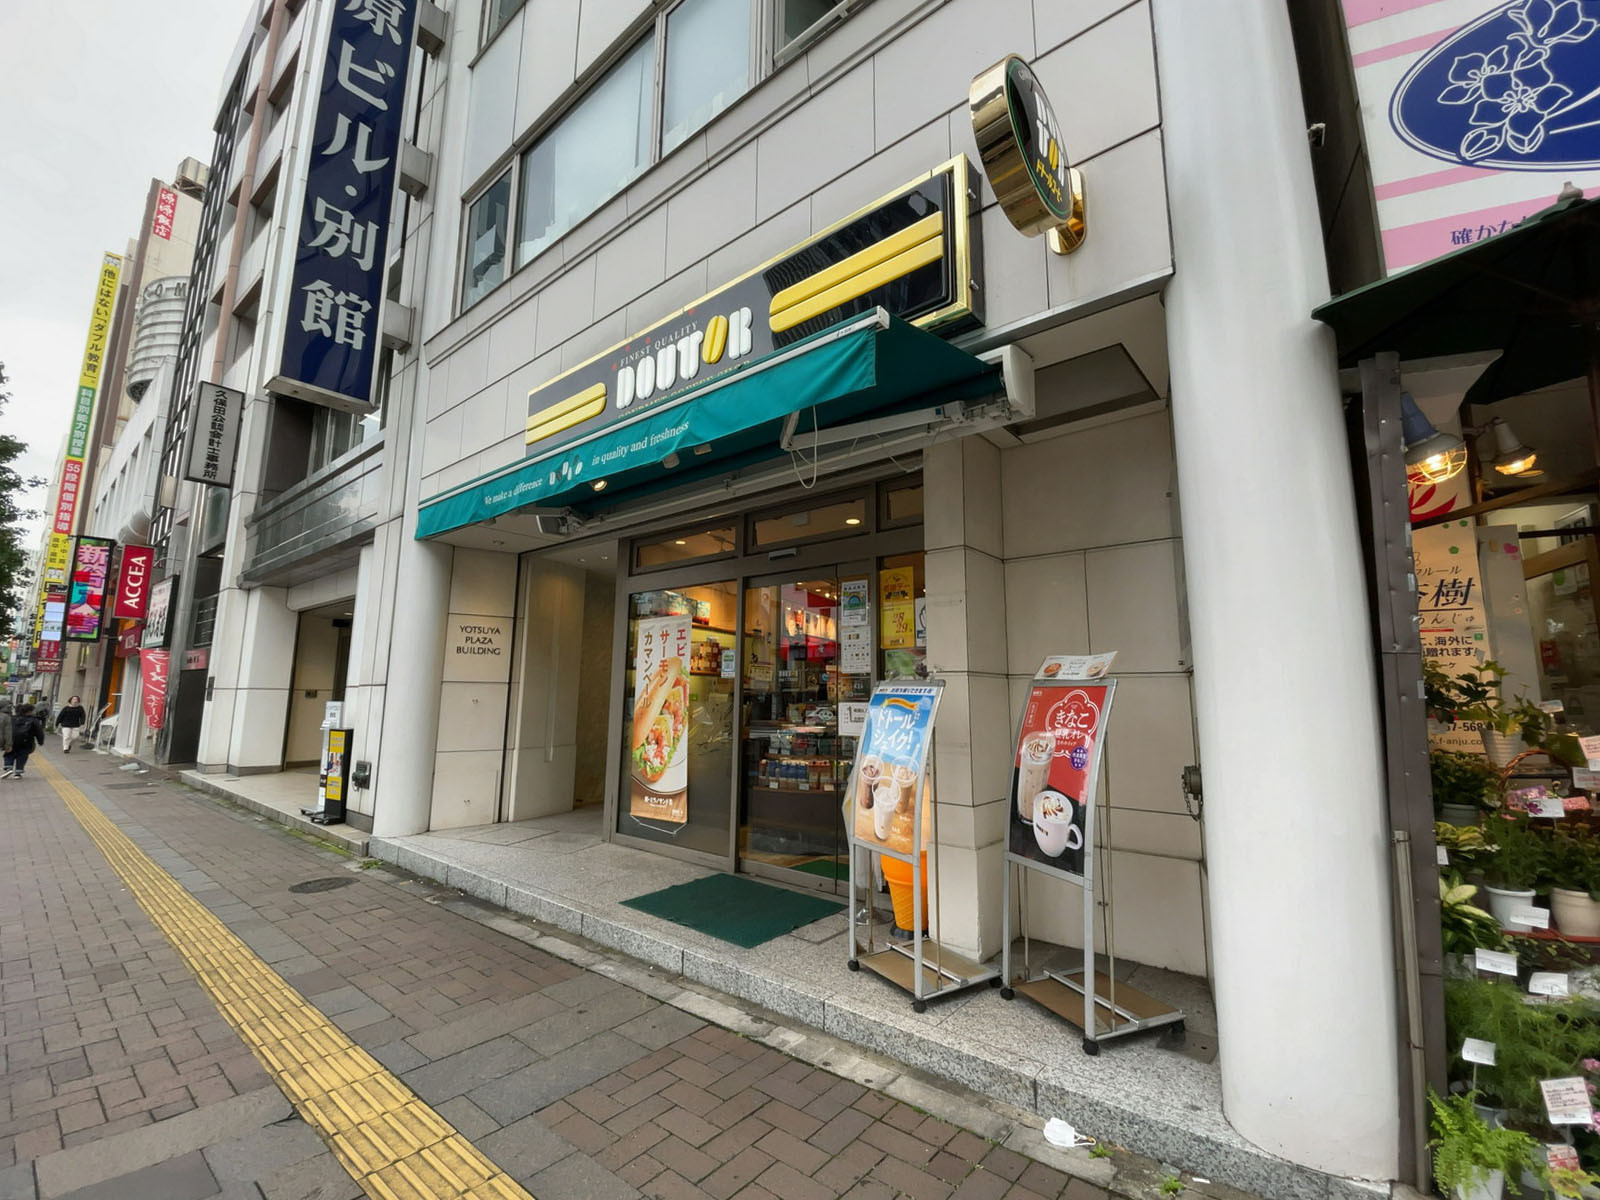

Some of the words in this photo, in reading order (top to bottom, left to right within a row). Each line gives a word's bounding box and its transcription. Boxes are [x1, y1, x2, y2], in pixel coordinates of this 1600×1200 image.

[616, 306, 753, 410] DOUTOR
[619, 345, 652, 368] FINEST
[654, 320, 699, 351] QUALITY
[592, 455, 600, 466] in
[601, 444, 629, 465] quality
[630, 436, 648, 452] and
[650, 421, 690, 447] freshness
[123, 556, 147, 609] ACCEA
[460, 625, 501, 635] YOTSUYA
[465, 636, 493, 645] PLAZA
[676, 628, 688, 656] エビ
[456, 646, 501, 656] BUILDING
[659, 629, 670, 688] サーモン
[642, 631, 653, 708] カマンベール
[877, 709, 916, 729] ドトール
[1054, 709, 1089, 728] きなこ
[874, 729, 914, 751] シェイク!
